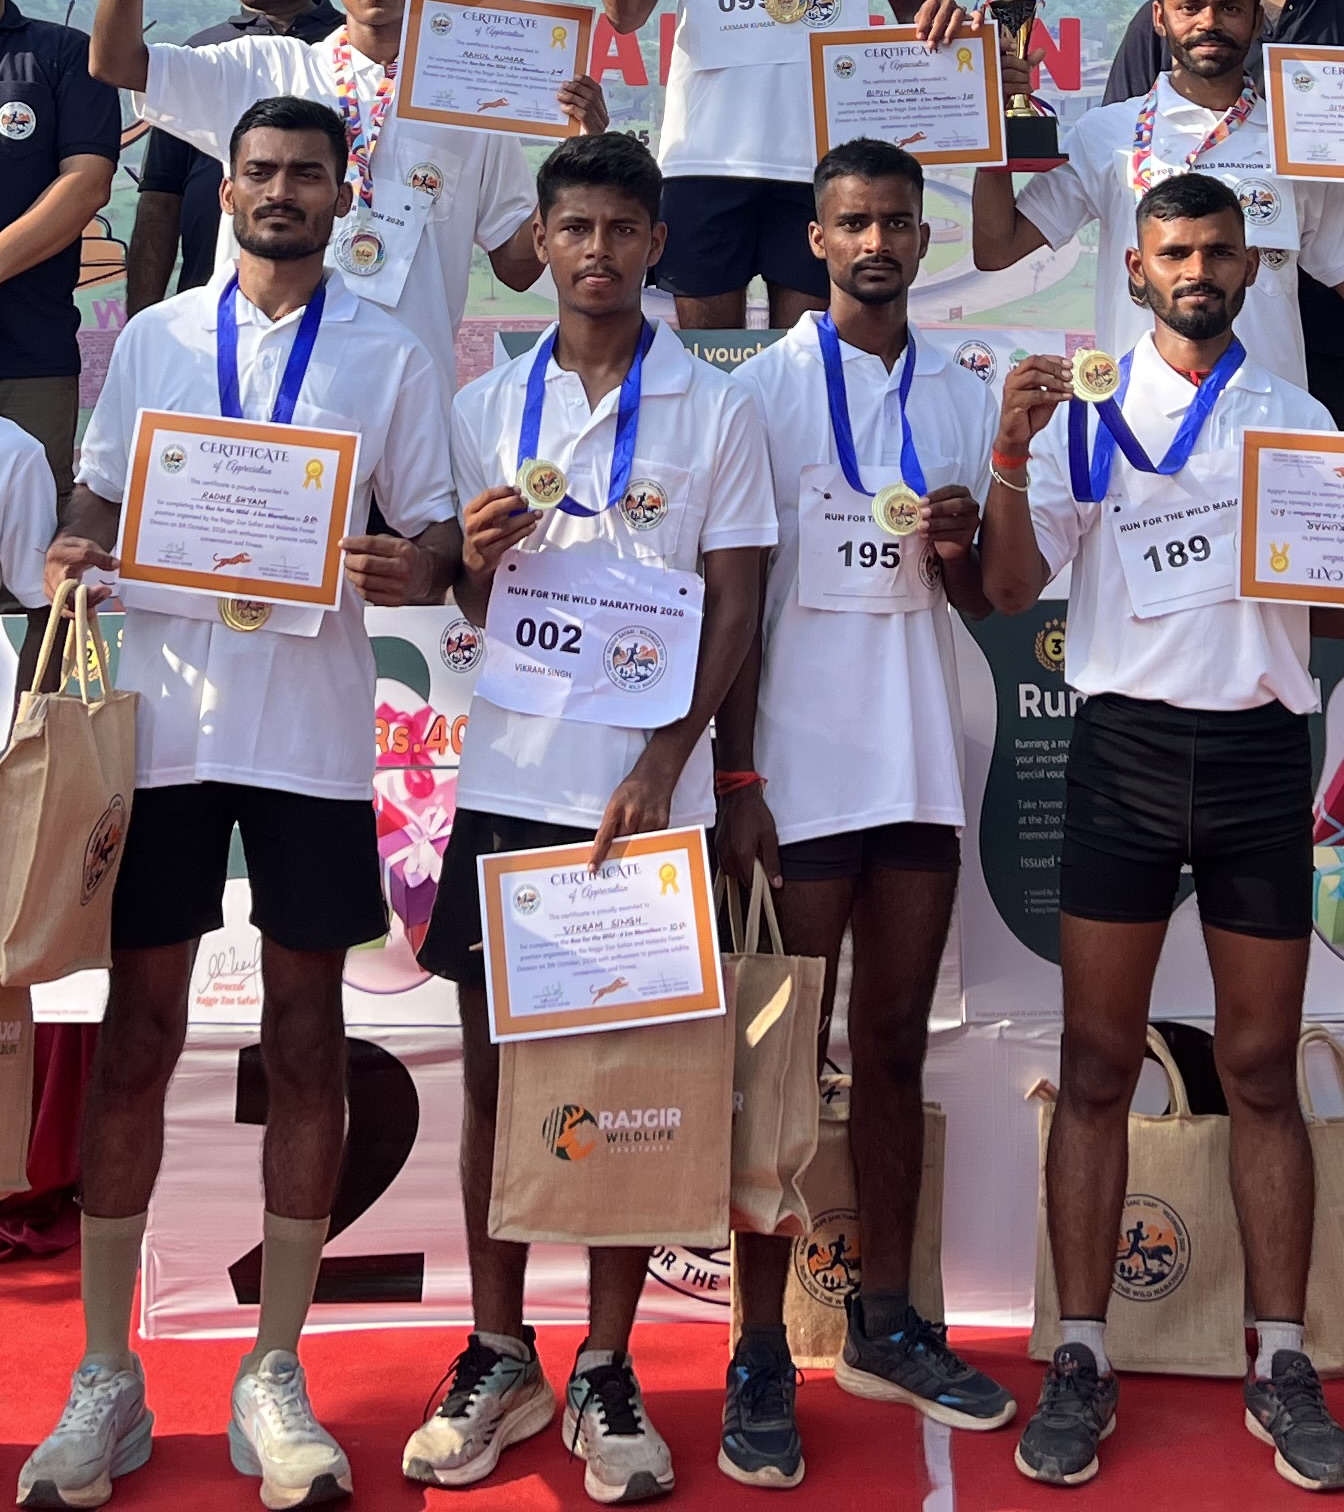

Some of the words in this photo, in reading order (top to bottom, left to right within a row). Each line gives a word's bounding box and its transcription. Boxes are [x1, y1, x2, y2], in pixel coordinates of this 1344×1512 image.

[462, 10, 537, 30] CERTIFICATE
[199, 440, 290, 464] CERTIFICATE
[824, 512, 845, 522] RUN
[847, 513, 866, 523] FOR
[1119, 521, 1141, 533] RUN
[1142, 515, 1163, 528] FOR
[1163, 511, 1185, 522] THE
[1185, 505, 1211, 517] WILD
[837, 540, 901, 569] 195
[1142, 534, 1212, 573] 189
[506, 585, 529, 597] RUN
[530, 589, 550, 600] FOR
[551, 591, 570, 602] THE
[571, 594, 598, 606] WILD
[599, 598, 658, 614] MARATHON
[515, 617, 583, 655] 002
[1014, 738, 1050, 752] Running
[1015, 754, 1034, 766] your
[1015, 768, 1045, 781] special
[1017, 799, 1038, 810] Take
[1020, 854, 1055, 869] Issued
[598, 1107, 682, 1131] RAJGIR
[606, 1129, 675, 1144] WILDLIFE
[682, 1262, 721, 1291] THE
